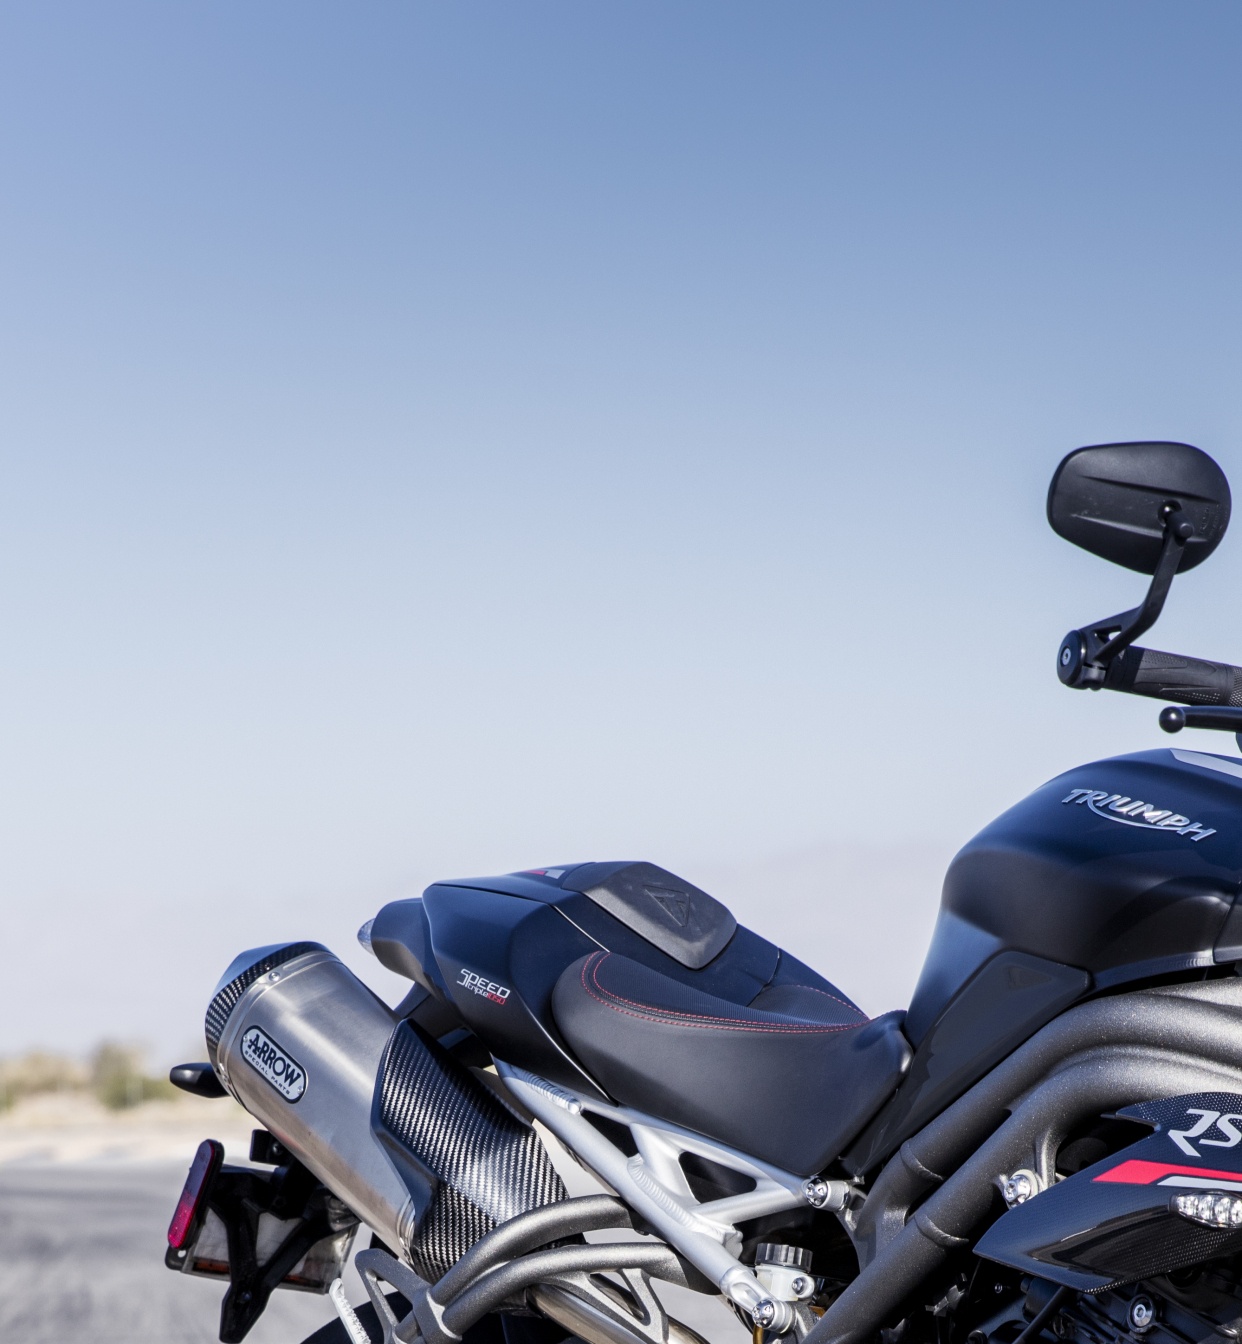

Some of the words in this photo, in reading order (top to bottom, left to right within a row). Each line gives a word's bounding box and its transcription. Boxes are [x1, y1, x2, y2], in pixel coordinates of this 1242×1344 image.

[1061, 788, 1217, 842] TRIUMPH
[456, 968, 511, 998] SPEED
[244, 1049, 269, 1076] SPECIAL
[270, 1075, 291, 1096] PARTS
[248, 1033, 302, 1087] ARROW
[1167, 1108, 1242, 1158] RS
